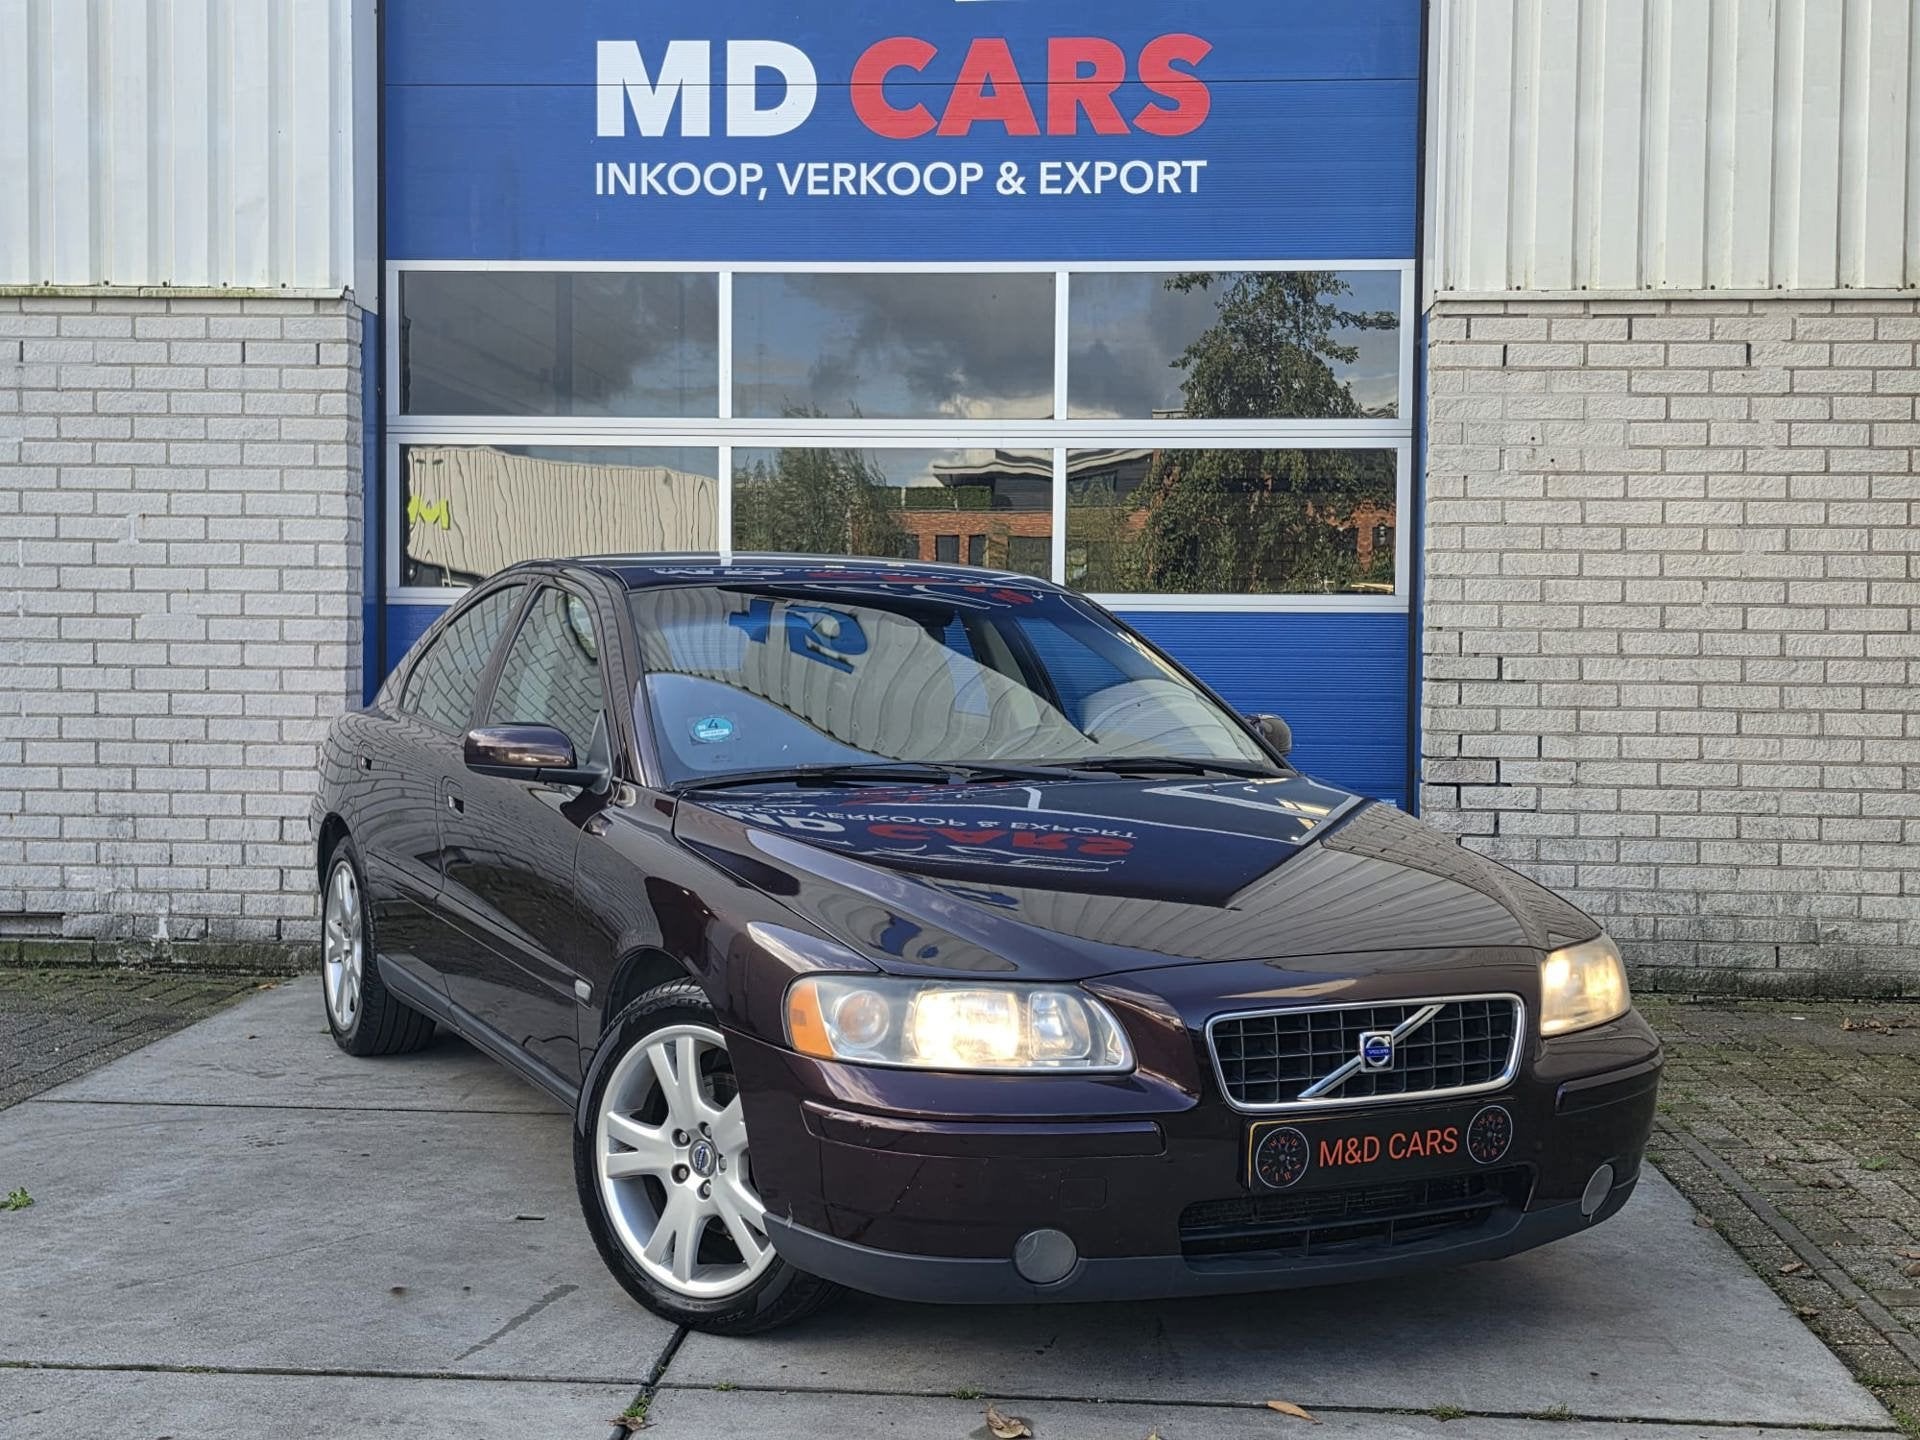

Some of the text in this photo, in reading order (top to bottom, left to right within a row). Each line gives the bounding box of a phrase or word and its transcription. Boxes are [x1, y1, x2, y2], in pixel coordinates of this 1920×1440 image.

[596, 33, 1213, 139] MD CARS
[595, 160, 1207, 200] INKOOP, VERKOOP & EXPORT
[1319, 1135, 1380, 1168] M&D
[1388, 1127, 1458, 1160] CARS
